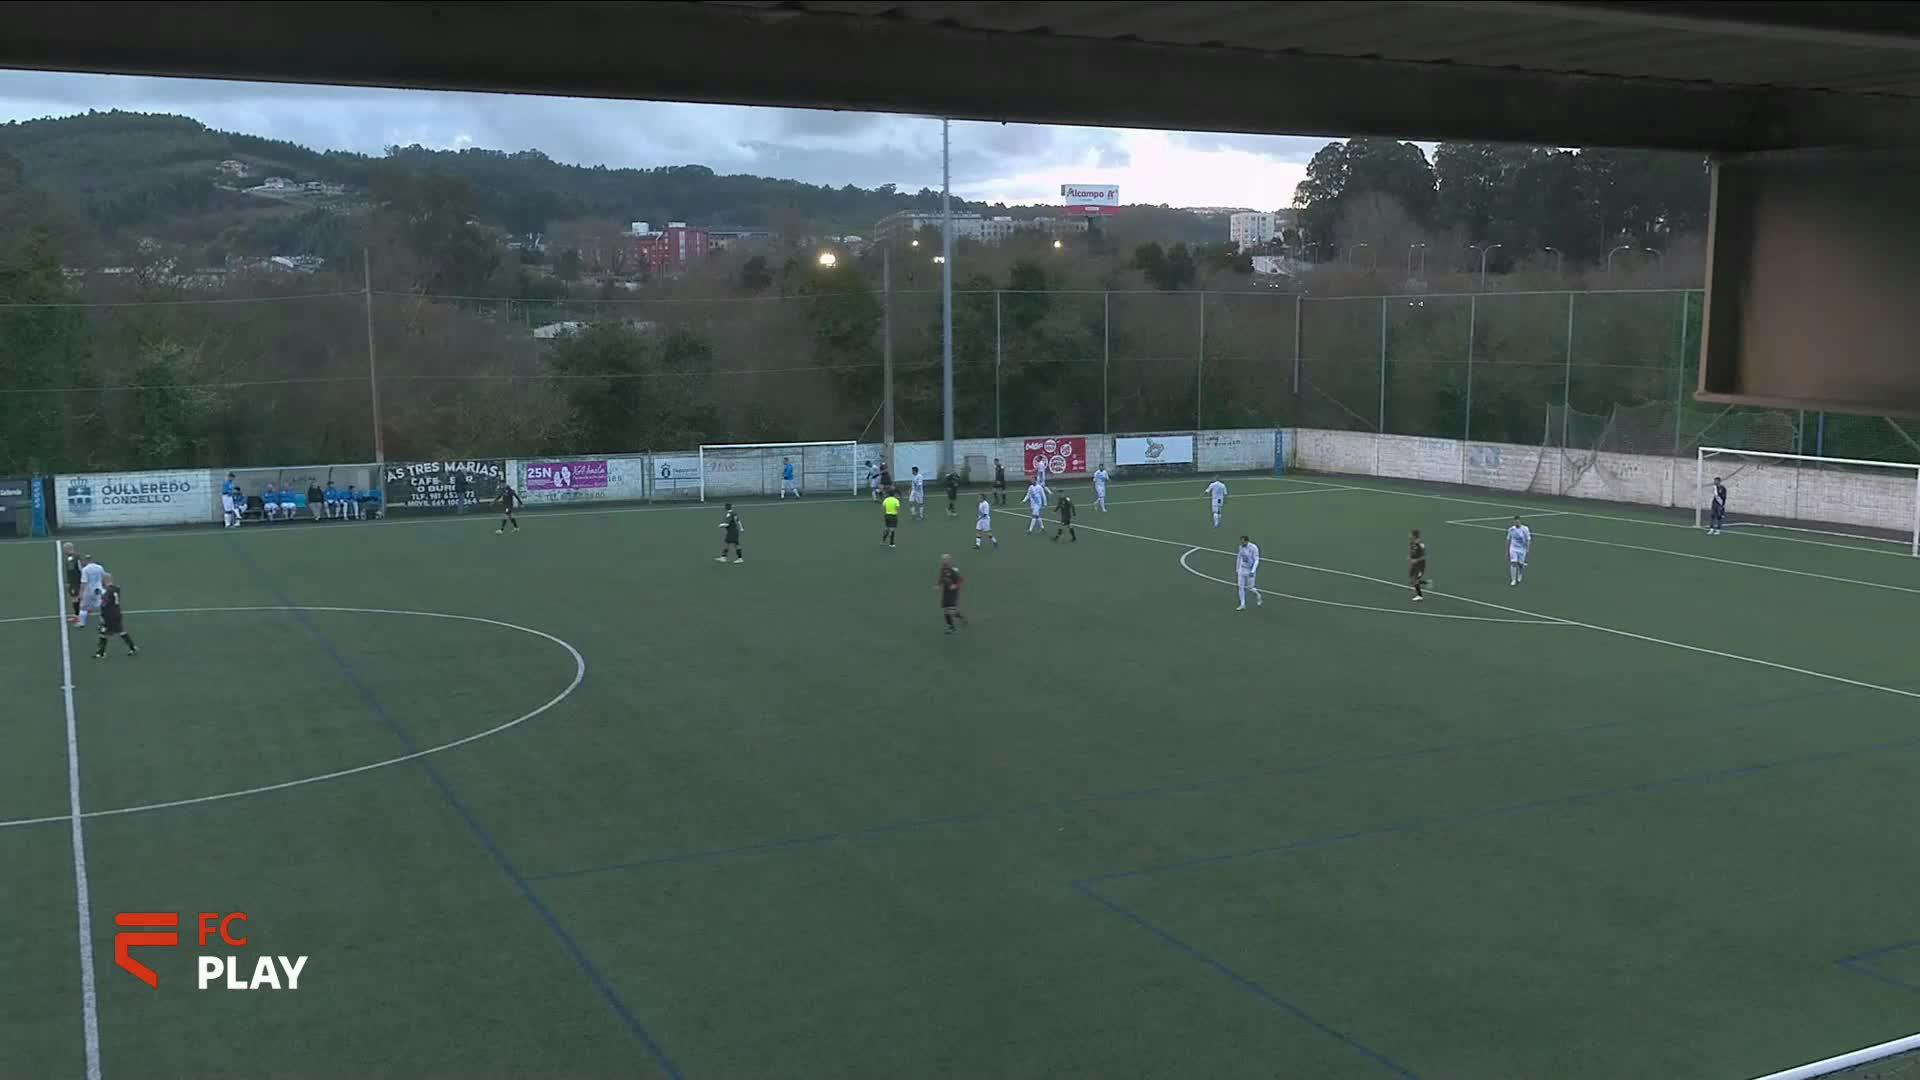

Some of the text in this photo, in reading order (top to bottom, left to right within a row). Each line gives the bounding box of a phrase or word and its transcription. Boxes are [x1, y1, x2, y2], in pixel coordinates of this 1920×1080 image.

[1066, 187, 1104, 198] Alcampo
[384, 468, 405, 482] AS
[407, 462, 440, 476] TRES
[527, 467, 552, 478] 25N
[102, 495, 171, 505] CONCELLO
